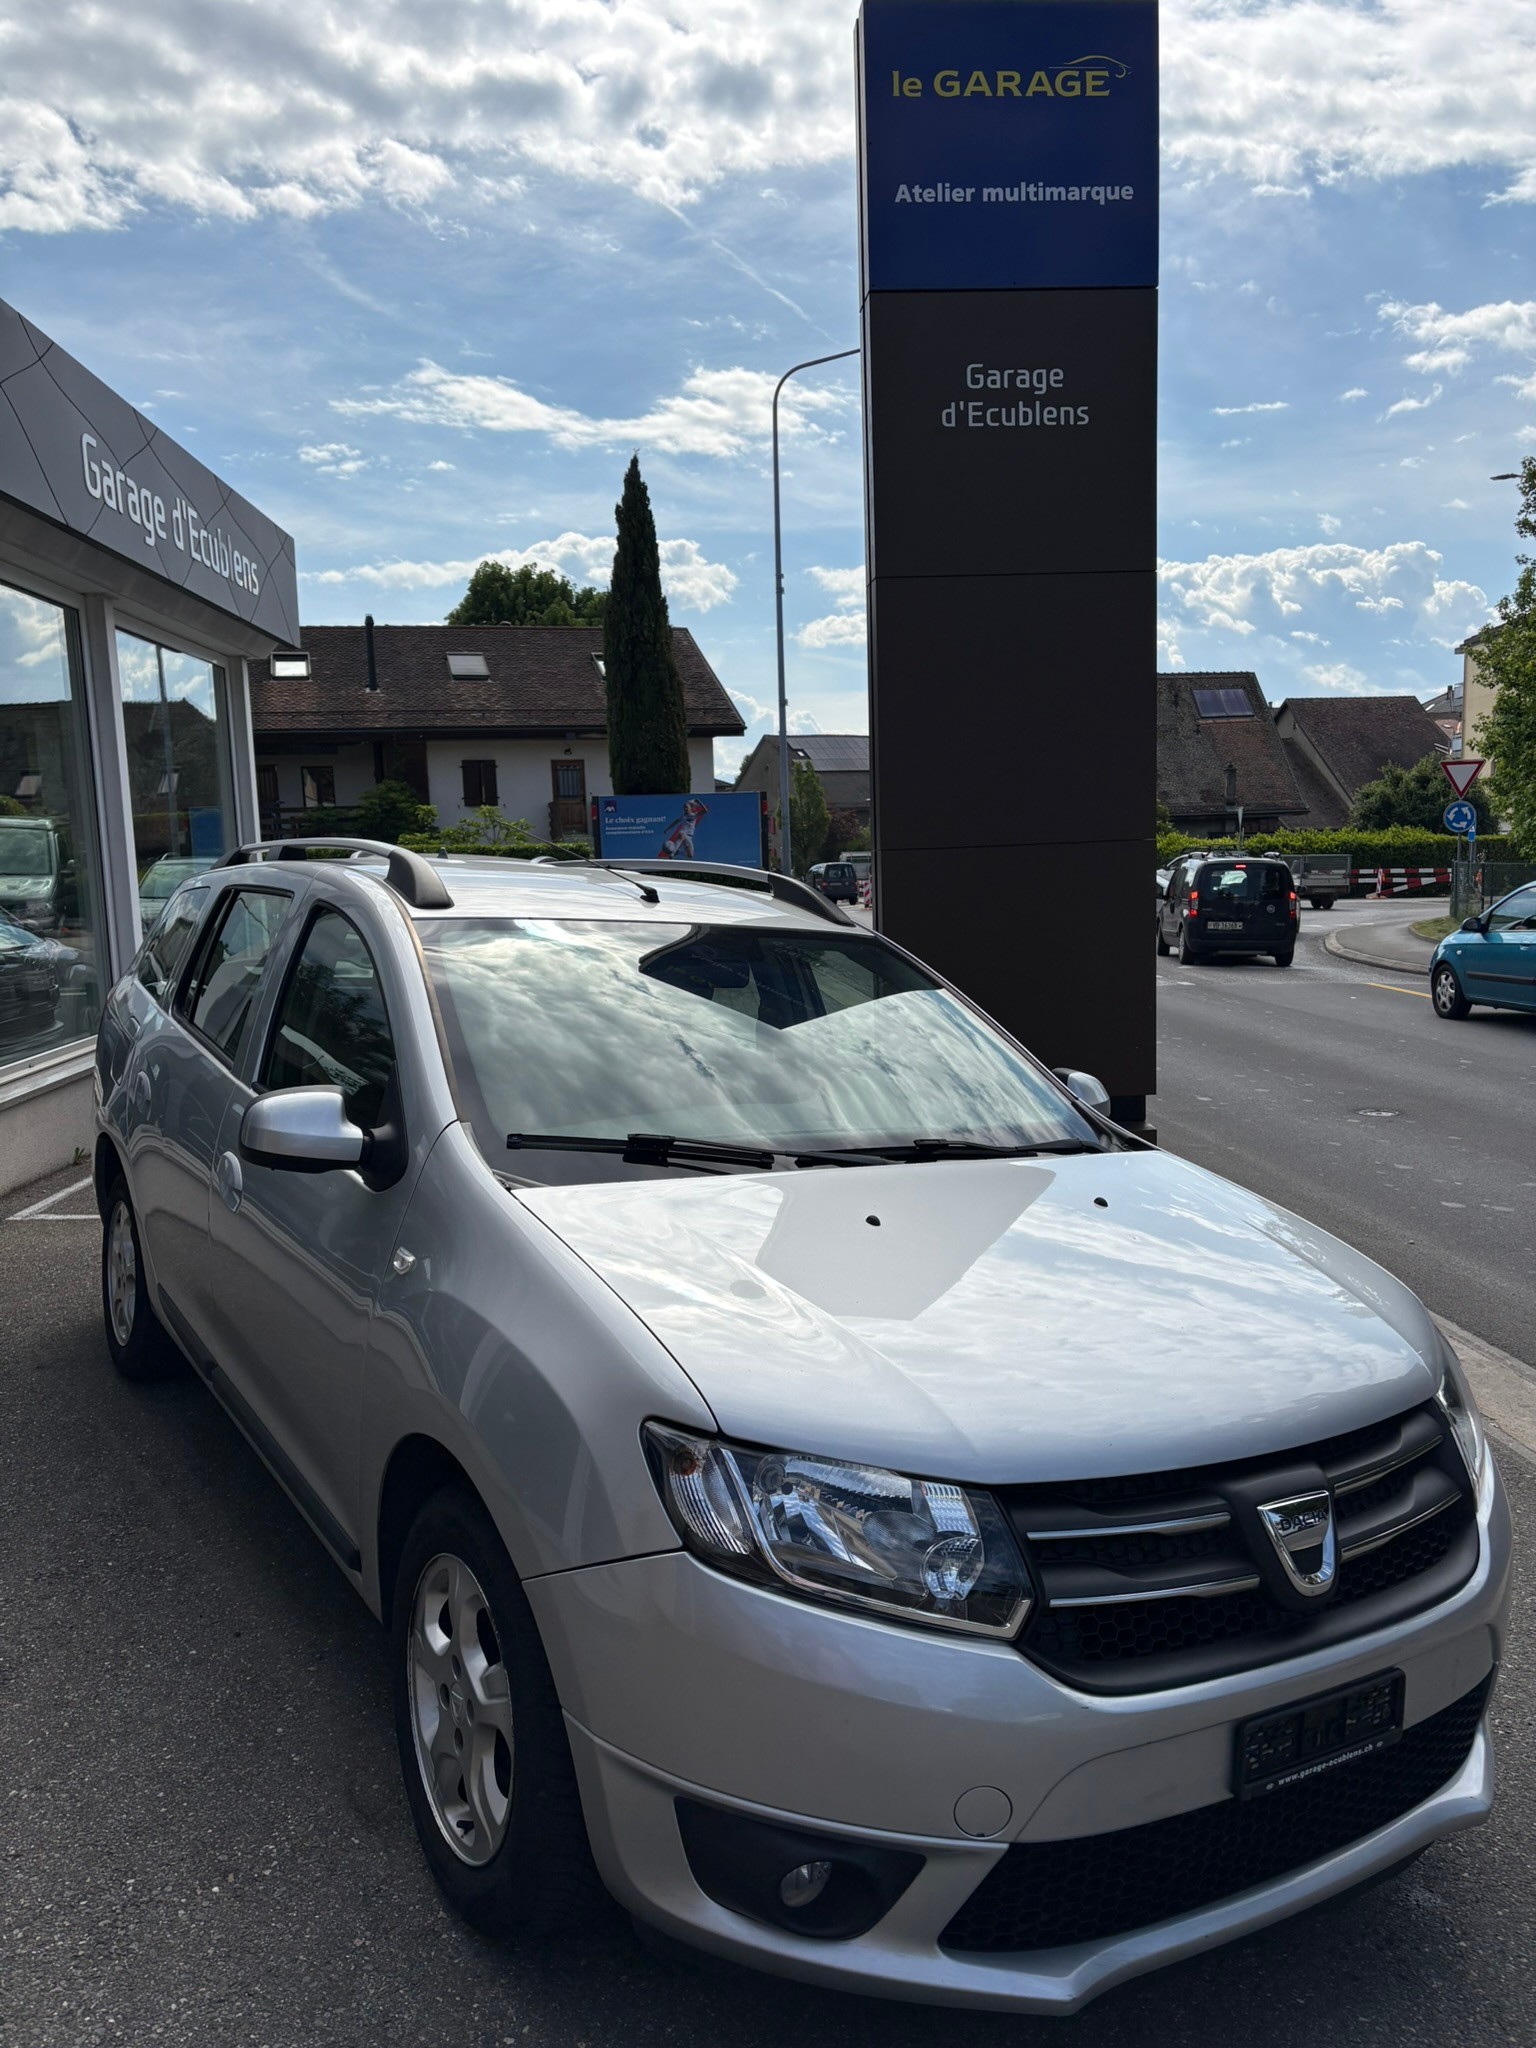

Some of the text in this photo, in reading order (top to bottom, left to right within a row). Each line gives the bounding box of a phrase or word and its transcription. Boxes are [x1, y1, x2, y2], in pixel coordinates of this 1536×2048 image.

[892, 70, 1111, 98] le GARAGE
[895, 182, 1135, 205] Atelier multimarque
[966, 363, 1065, 395] Garage
[941, 401, 1090, 428] d'Ecublens
[81, 432, 259, 596] Garage d'Ecublens
[1279, 1509, 1328, 1532] DACIA
